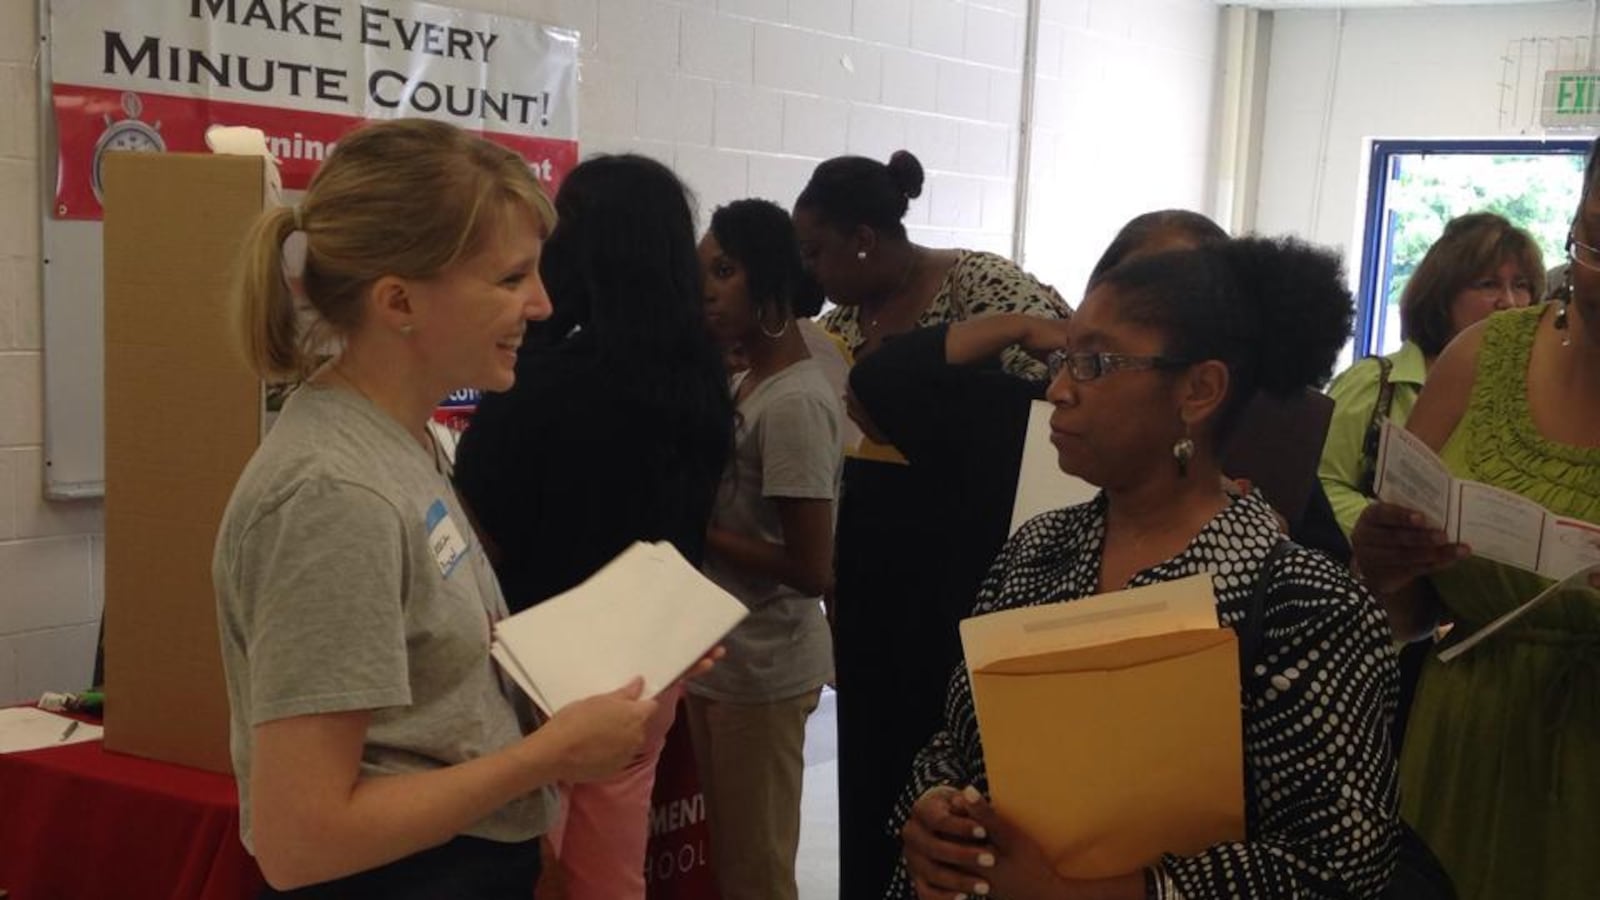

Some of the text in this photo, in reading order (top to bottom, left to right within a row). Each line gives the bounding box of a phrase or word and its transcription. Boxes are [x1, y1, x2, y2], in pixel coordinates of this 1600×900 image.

[360, 5, 498, 62] EVERY
[103, 30, 549, 127] MINUTE COUNT!
[1557, 76, 1600, 114] EXI
[265, 132, 338, 161] nin
